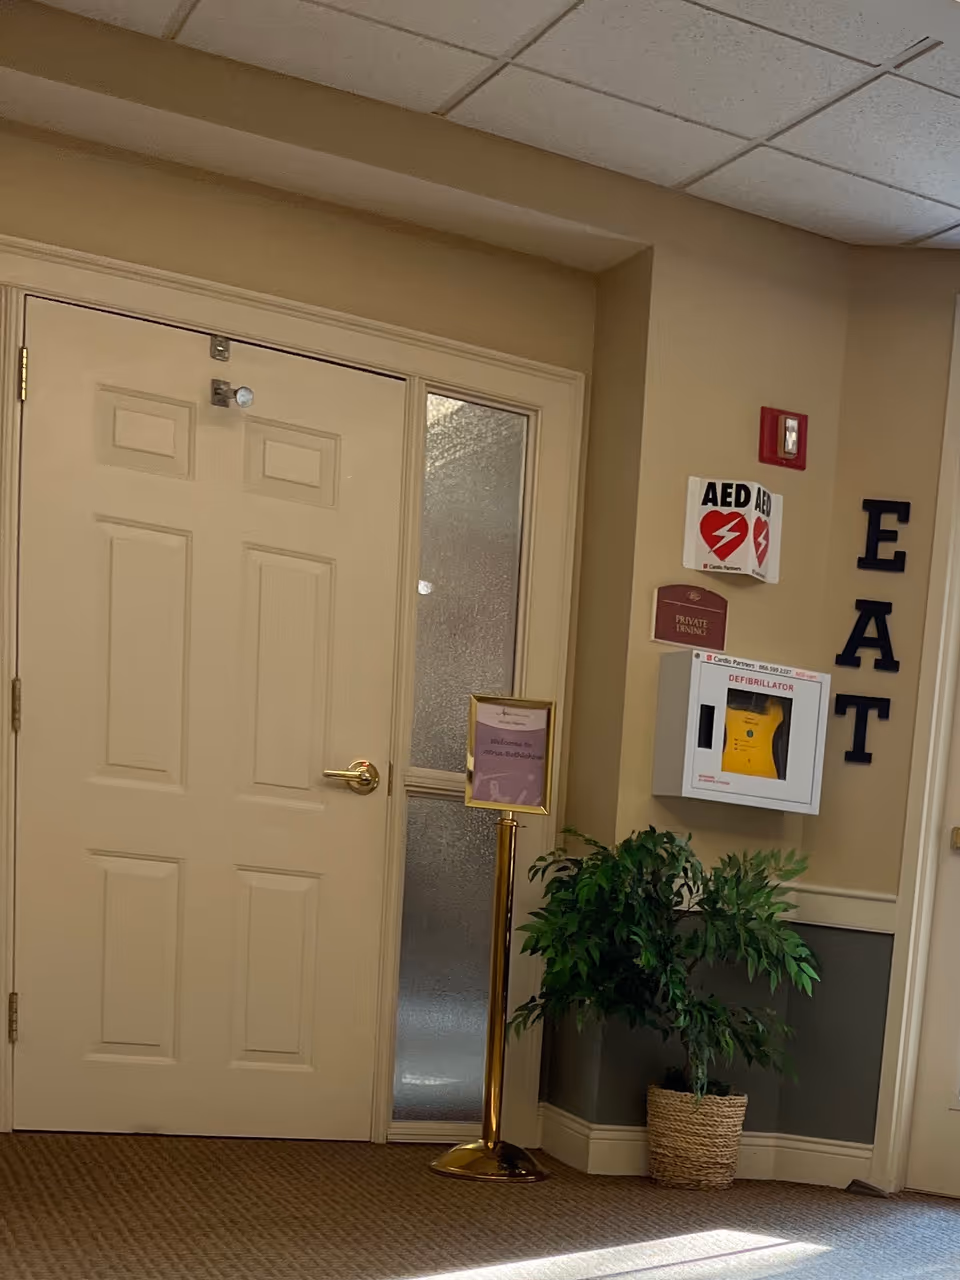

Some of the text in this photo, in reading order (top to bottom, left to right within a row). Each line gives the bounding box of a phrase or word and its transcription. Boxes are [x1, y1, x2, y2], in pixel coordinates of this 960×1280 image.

[701, 481, 751, 509] AED
[754, 486, 772, 518] AED
[675, 614, 708, 628] PRIVATE
[676, 623, 706, 636] DINING
[835, 498, 911, 765] EAT
[713, 655, 732, 666] Cardio
[732, 658, 755, 669] Partners
[728, 674, 794, 692] DEFIBRILLATOR
